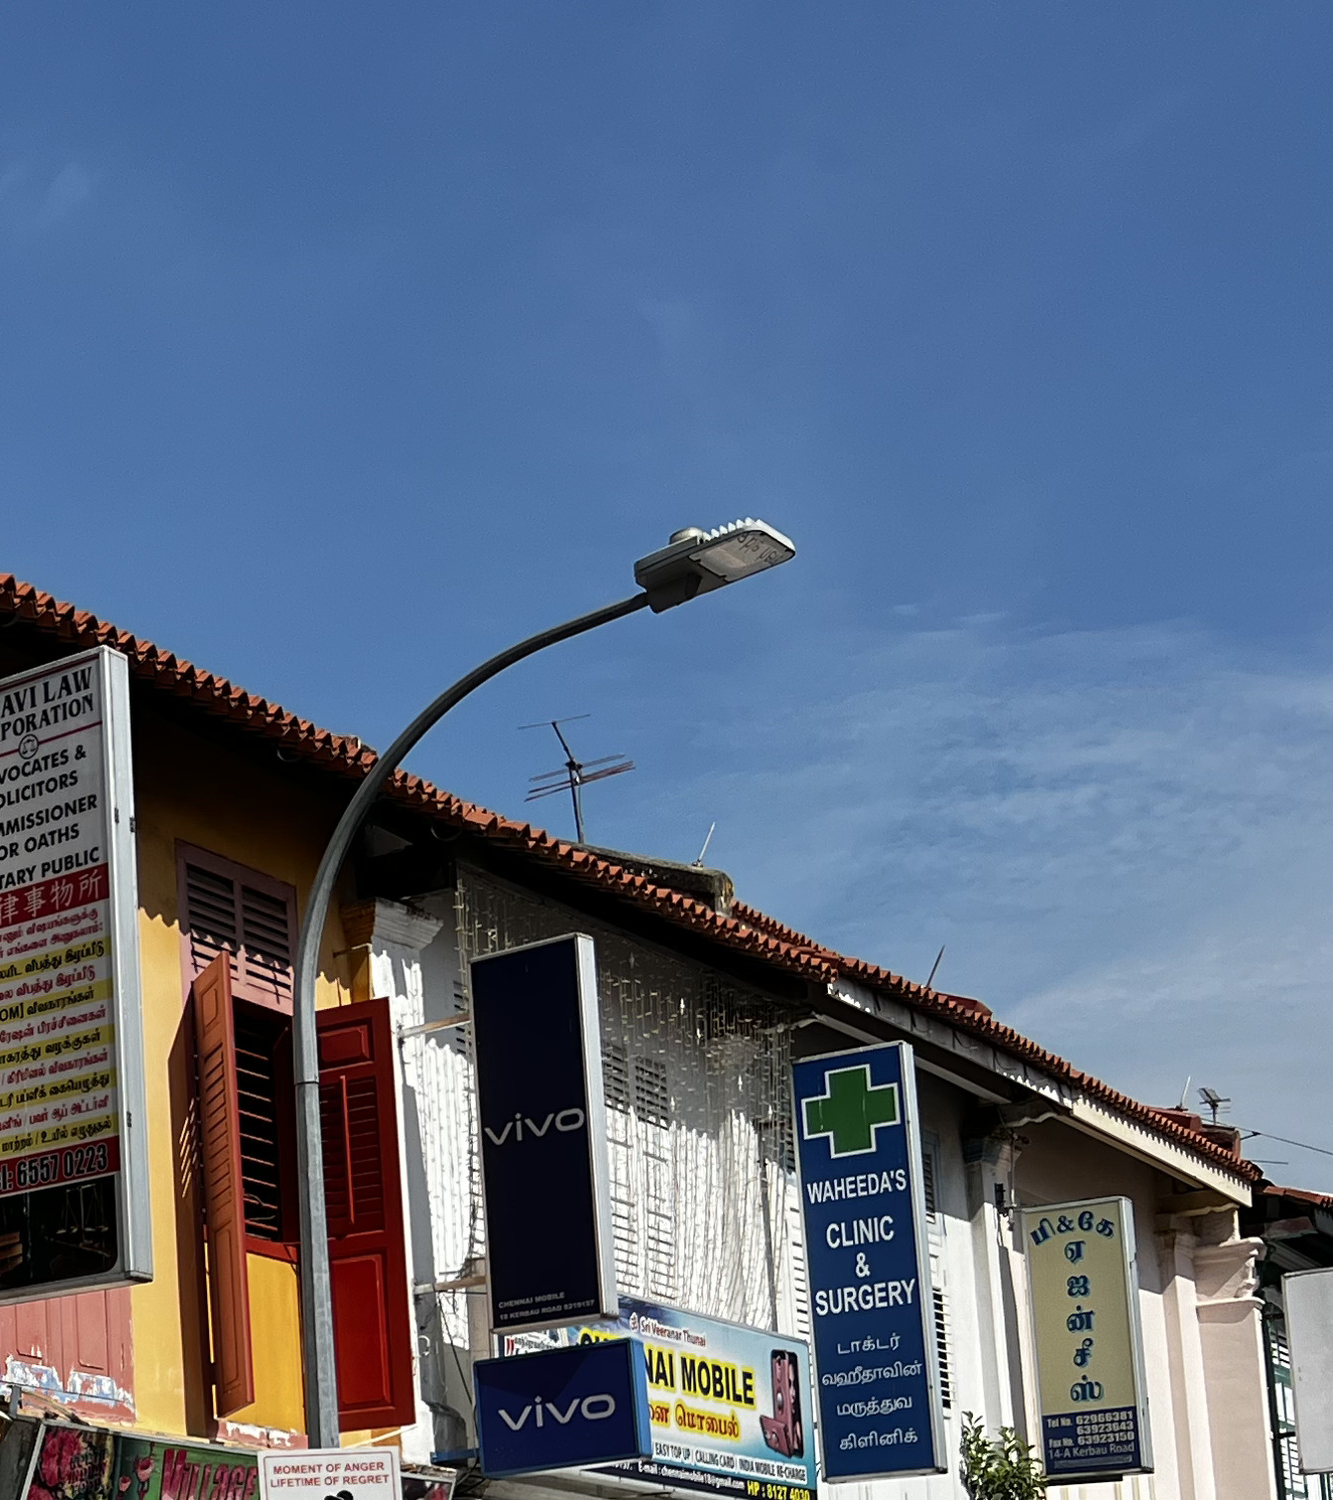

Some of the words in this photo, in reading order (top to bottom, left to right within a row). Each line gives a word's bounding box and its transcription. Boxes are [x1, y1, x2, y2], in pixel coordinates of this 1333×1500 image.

[43, 667, 93, 703] LAW
[74, 744, 87, 761] &
[24, 823, 80, 853] OATHS
[41, 846, 100, 878] PUBLIC
[484, 1107, 585, 1146] vivo
[17, 1153, 59, 1187] 6557
[63, 1143, 108, 1177] 0223
[807, 1169, 907, 1204] WAHEEDA'S
[826, 1216, 894, 1248] CLINIC
[856, 1252, 870, 1278] &
[815, 1279, 915, 1316] SURGERY
[681, 1356, 754, 1405] MOBILE
[497, 1391, 616, 1432] vivo
[1110, 1442, 1134, 1454] Road
[270, 1477, 321, 1488] LIFETIME
[324, 1476, 340, 1486] OF
[342, 1474, 389, 1485] REGRET
[273, 1464, 323, 1475] MOMENT
[325, 1463, 342, 1473] OF
[344, 1461, 385, 1472] ANGER
[747, 1481, 760, 1496] HP
